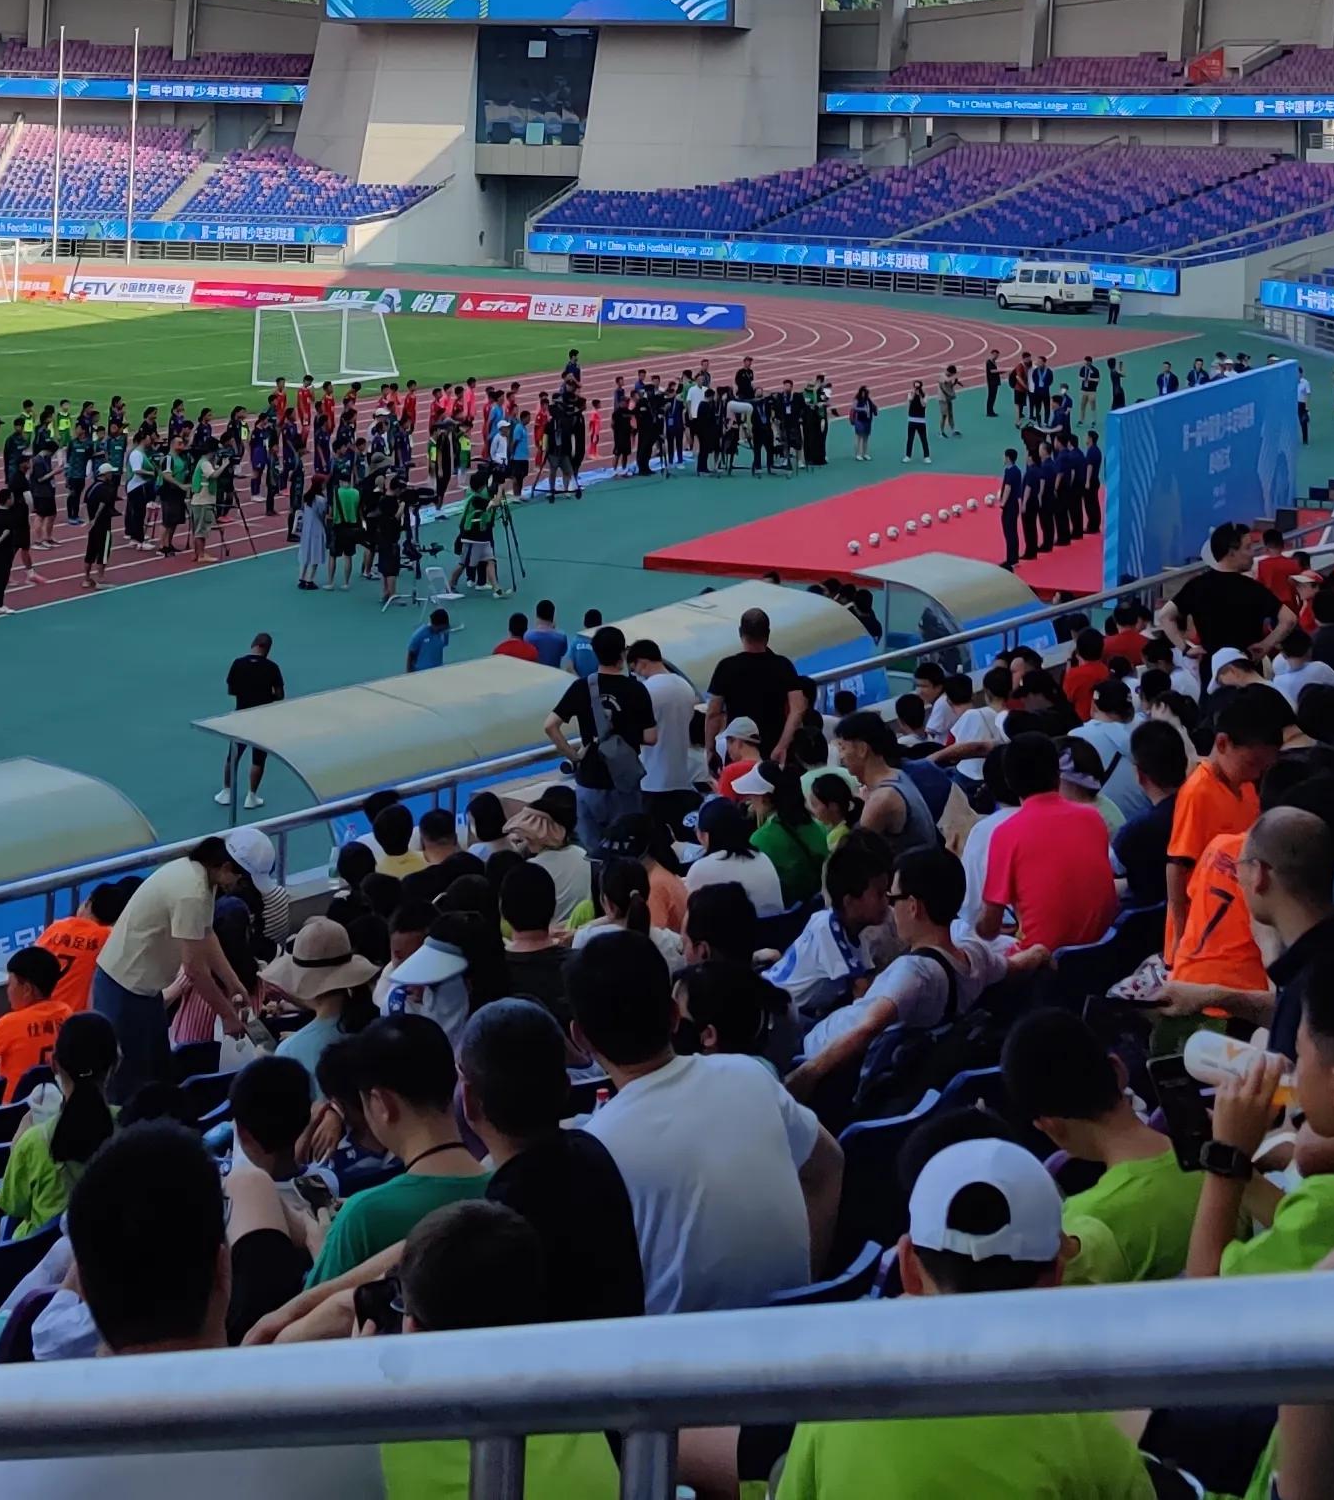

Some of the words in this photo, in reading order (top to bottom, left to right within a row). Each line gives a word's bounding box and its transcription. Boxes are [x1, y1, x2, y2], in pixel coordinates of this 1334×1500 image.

[127, 84, 263, 99] 第一届中国青少年足球联赛
[71, 281, 116, 296] CETV
[119, 282, 186, 295] 中国教育电视台
[533, 301, 597, 319] 世达足球
[1191, 886, 1235, 958] 7
